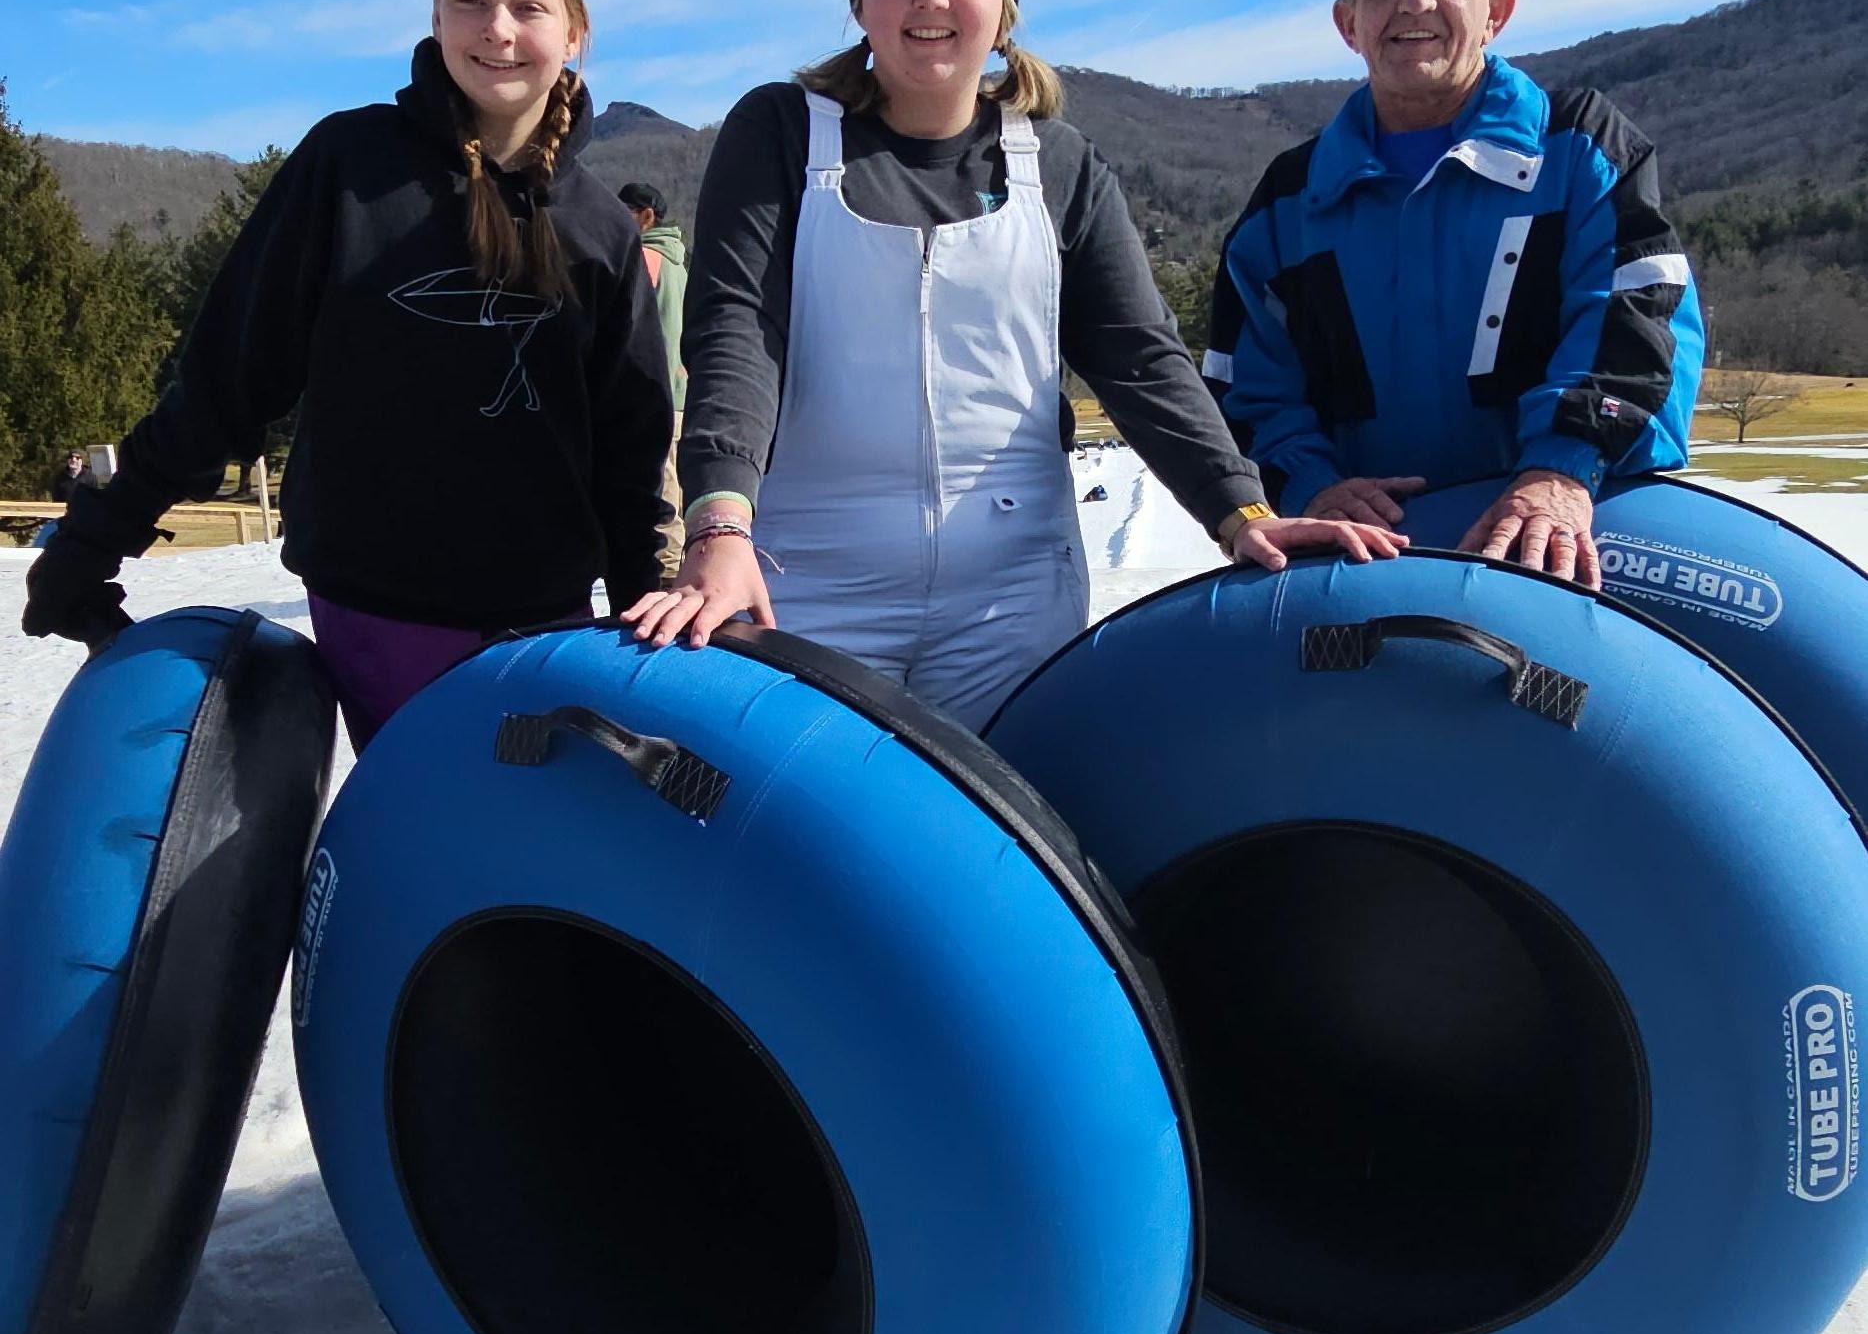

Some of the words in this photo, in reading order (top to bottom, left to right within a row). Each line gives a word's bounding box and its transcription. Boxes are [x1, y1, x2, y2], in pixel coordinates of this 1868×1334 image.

[1600, 531, 1776, 582] TUBEPROINC.COM
[1600, 549, 1670, 584] PRO
[1602, 584, 1677, 607] CANAD
[1673, 565, 1766, 613] TUBE
[1681, 602, 1702, 613] IN
[1707, 609, 1768, 632] MADE
[301, 866, 329, 948] TUBE
[1782, 1004, 1796, 1100] CANADA
[1805, 1003, 1839, 1081] PRO
[1843, 992, 1861, 1184] TUBEPROINC.COM
[1788, 1106, 1796, 1126] IN
[1809, 1086, 1840, 1187] TUBE
